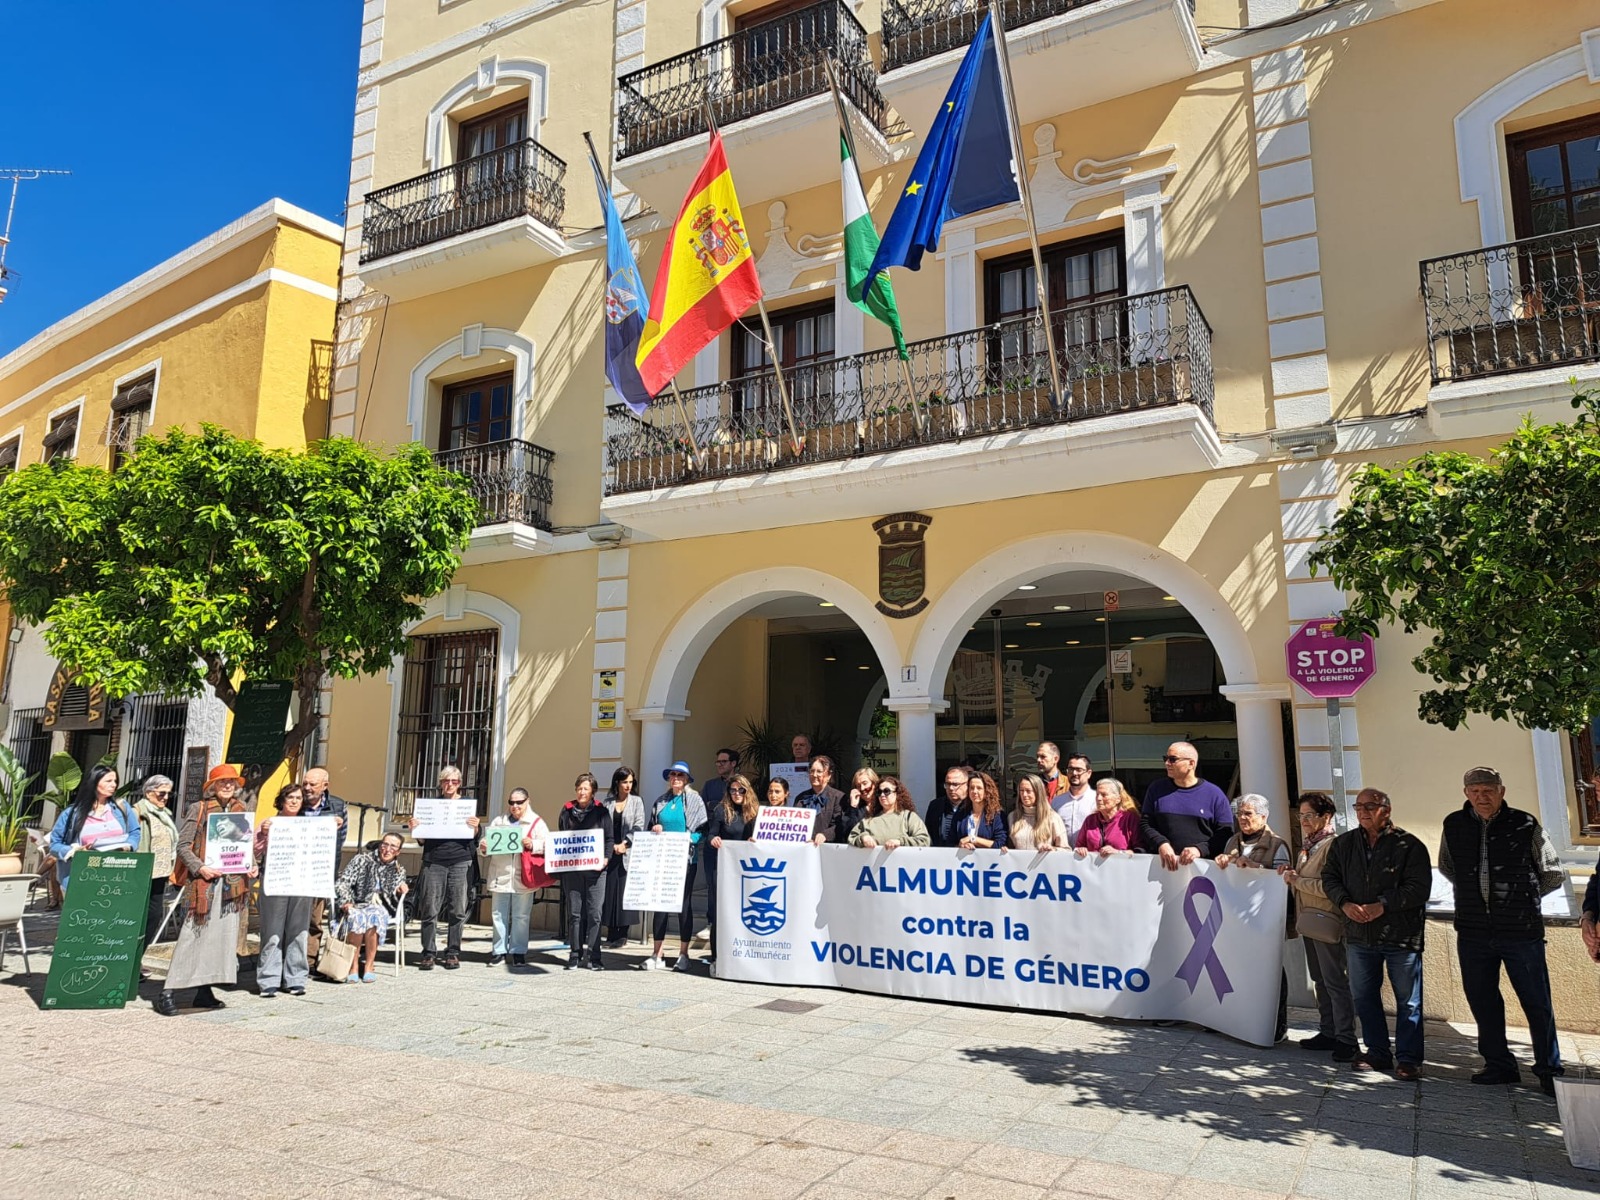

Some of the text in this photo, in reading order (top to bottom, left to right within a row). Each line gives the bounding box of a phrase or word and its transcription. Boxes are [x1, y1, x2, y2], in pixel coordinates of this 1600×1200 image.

[1297, 648, 1366, 667] STOP
[906, 668, 911, 680] 1
[1318, 666, 1364, 674] VIOLENCIA
[1319, 674, 1355, 682] GENERO
[762, 808, 811, 820] HARTAS
[759, 822, 808, 833] VIOLENCIA
[490, 831, 519, 852] 28
[756, 831, 807, 842] MACHISTA
[554, 846, 595, 855] MACHISTA
[102, 856, 138, 865] Alhambra
[549, 857, 600, 868] TERRORISMO
[110, 871, 129, 882] del
[855, 862, 1083, 903] ALMUÑÉCAR
[902, 915, 1030, 941] contra la
[732, 937, 792, 950] Ayuntamiento
[732, 948, 791, 961] de Almuñécar
[811, 940, 1151, 993] VIOLENCIA DE GÉNERO
